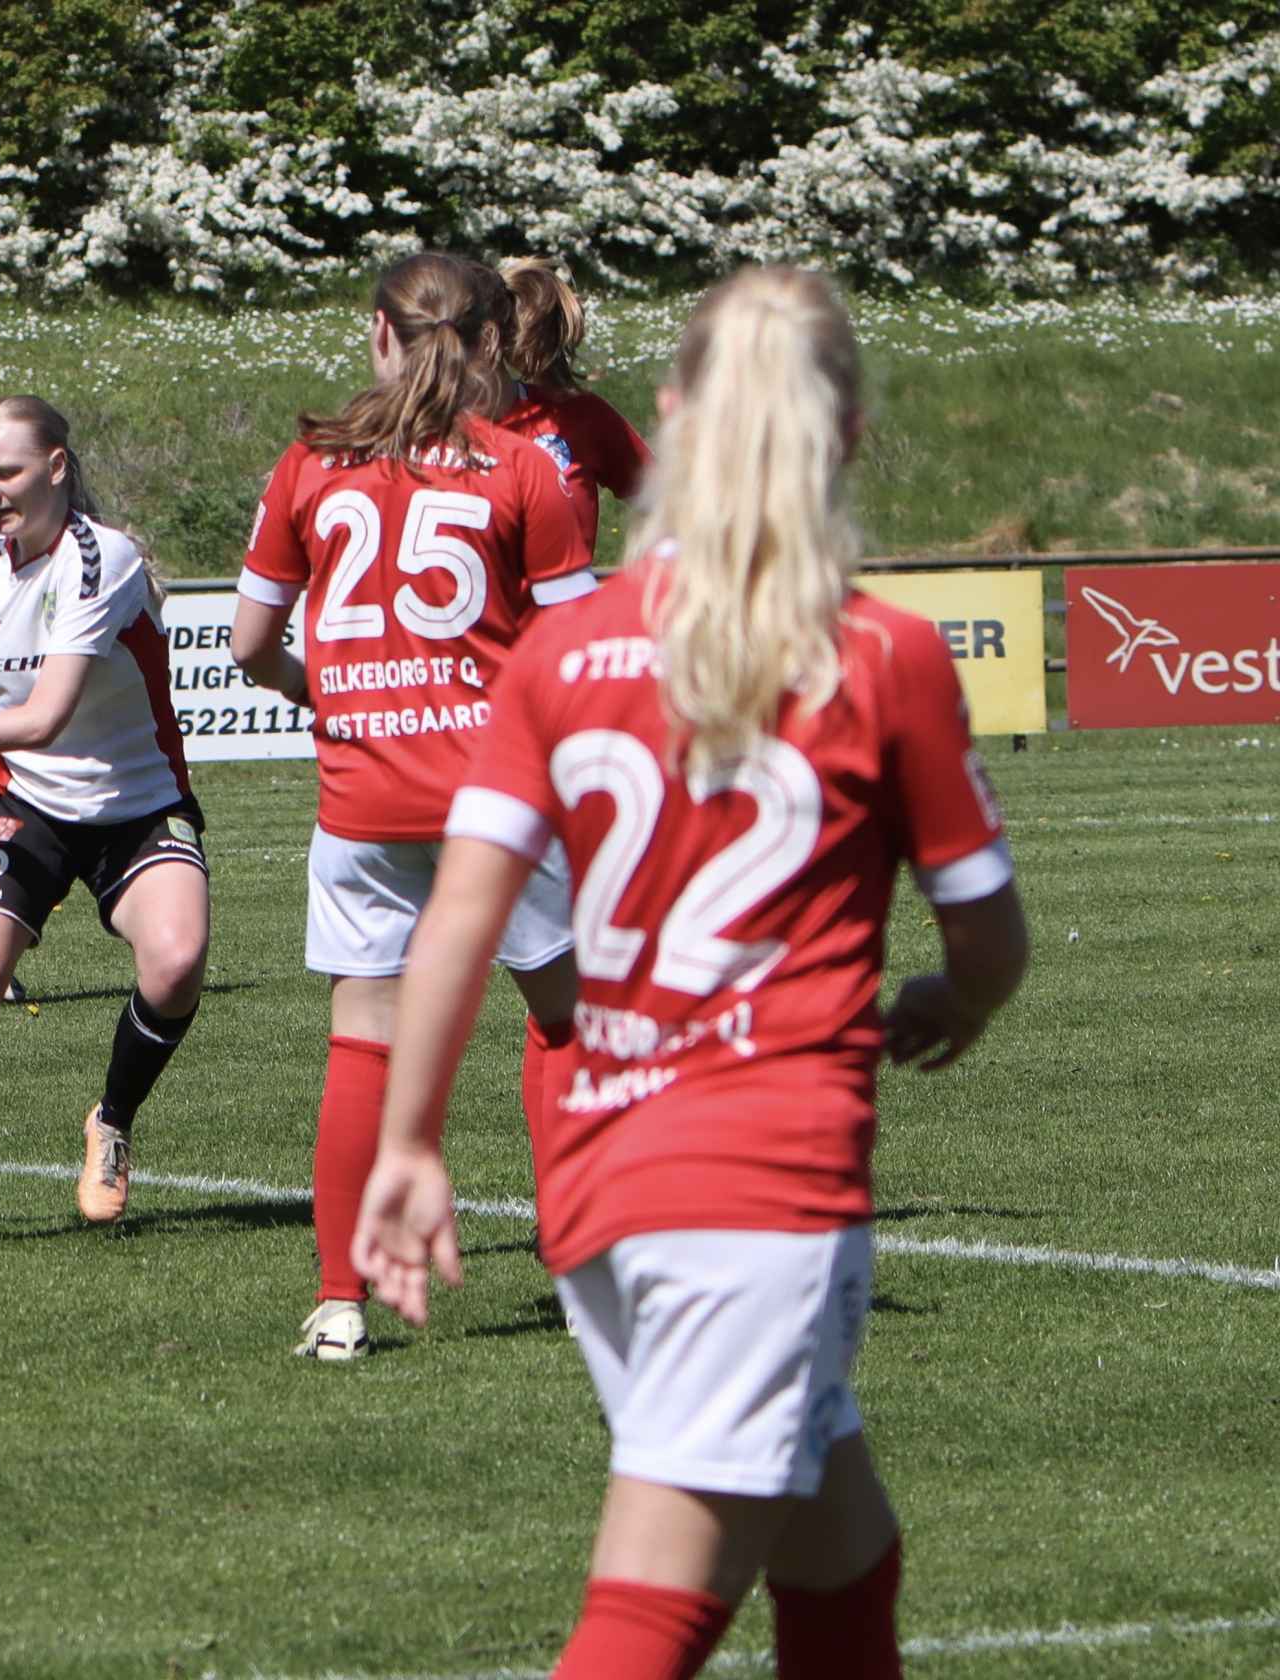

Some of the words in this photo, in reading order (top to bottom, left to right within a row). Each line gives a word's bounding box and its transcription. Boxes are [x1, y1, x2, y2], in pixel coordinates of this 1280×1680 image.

[314, 490, 491, 642] 25
[939, 620, 1006, 658] ER
[320, 657, 428, 695] SILKEBORG
[430, 657, 454, 685] IF
[460, 656, 483, 688] Q
[326, 701, 491, 740] ØSTERGAARD
[551, 730, 822, 996] 22
